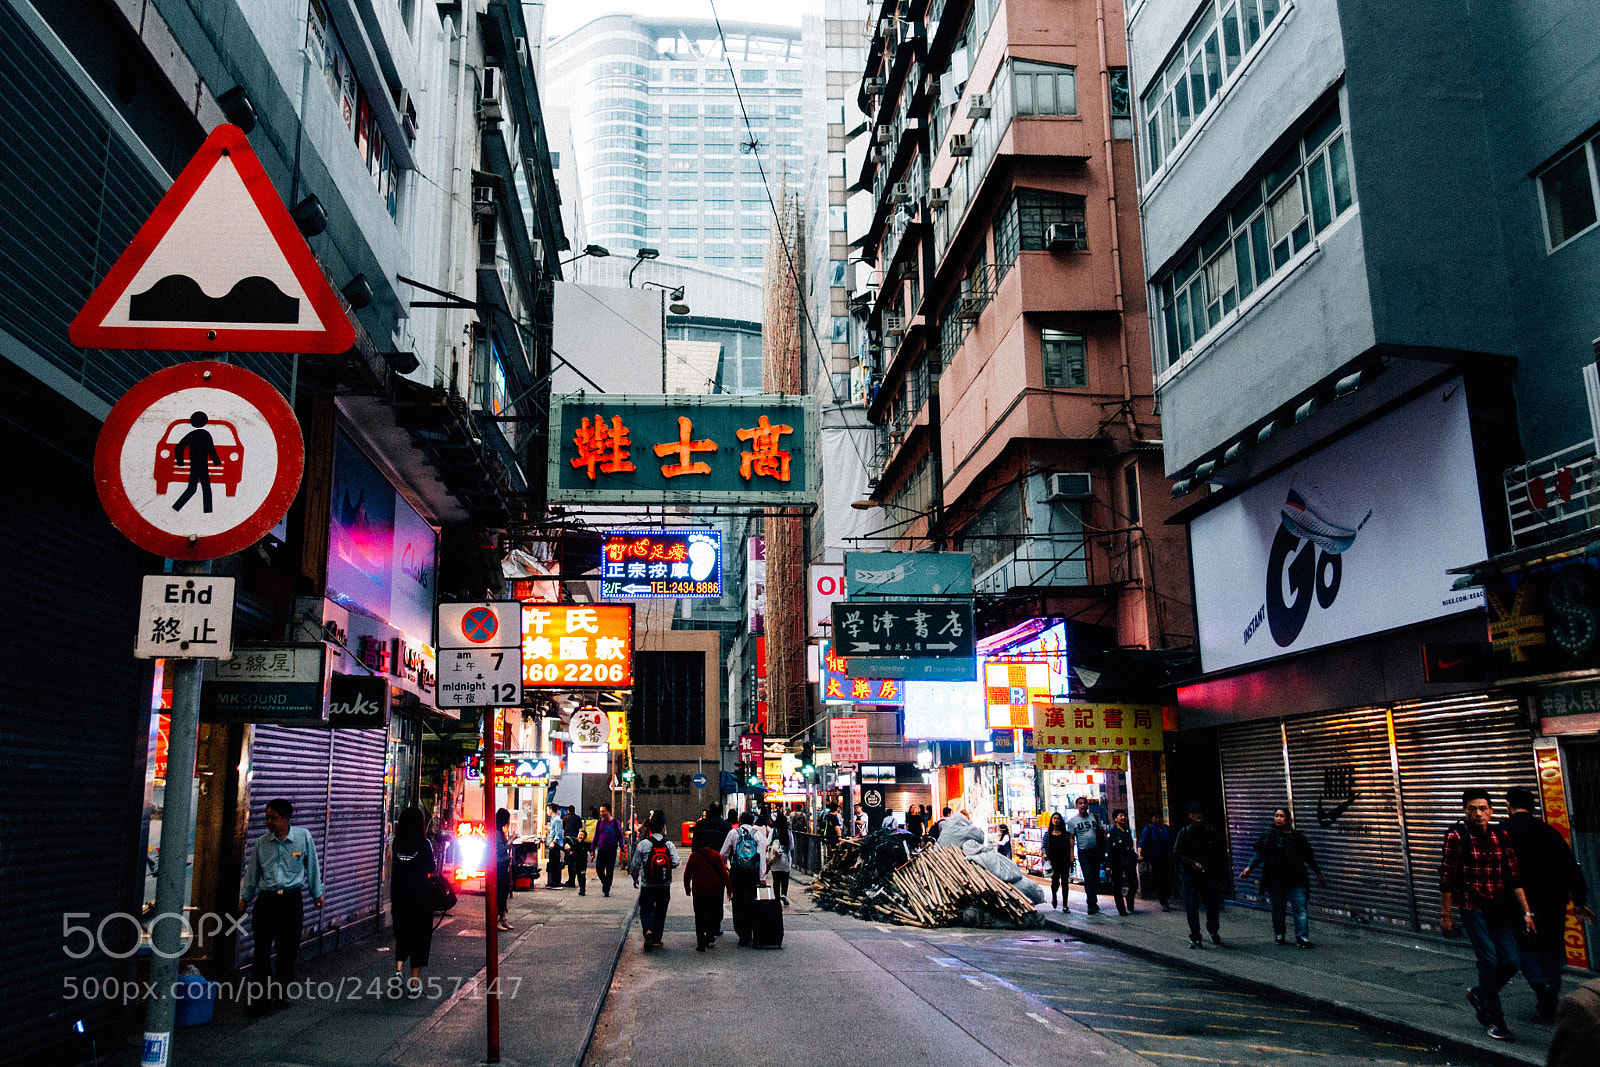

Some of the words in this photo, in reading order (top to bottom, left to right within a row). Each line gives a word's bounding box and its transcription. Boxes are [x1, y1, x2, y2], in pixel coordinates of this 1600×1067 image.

[606, 562, 689, 578] 正宗按摩
[165, 584, 212, 604] End
[605, 582, 622, 593] 2/F
[696, 582, 719, 593] 8886
[1442, 591, 1484, 606] NIKE.COM/REAC
[151, 617, 217, 644] 終止
[1243, 604, 1266, 645] INSTANT
[522, 636, 625, 660] 換匯款
[453, 662, 475, 671] 上午
[491, 653, 504, 671] 7
[564, 664, 623, 681] 2206
[217, 693, 287, 704] MKSOUND
[442, 682, 486, 692] midnight
[491, 683, 516, 702] 12
[453, 693, 475, 704] 午夜
[329, 692, 380, 715] arks
[1044, 707, 1152, 729] 漢記書局
[1043, 754, 1122, 766] 漢記書局
[517, 776, 548, 785] Massage
